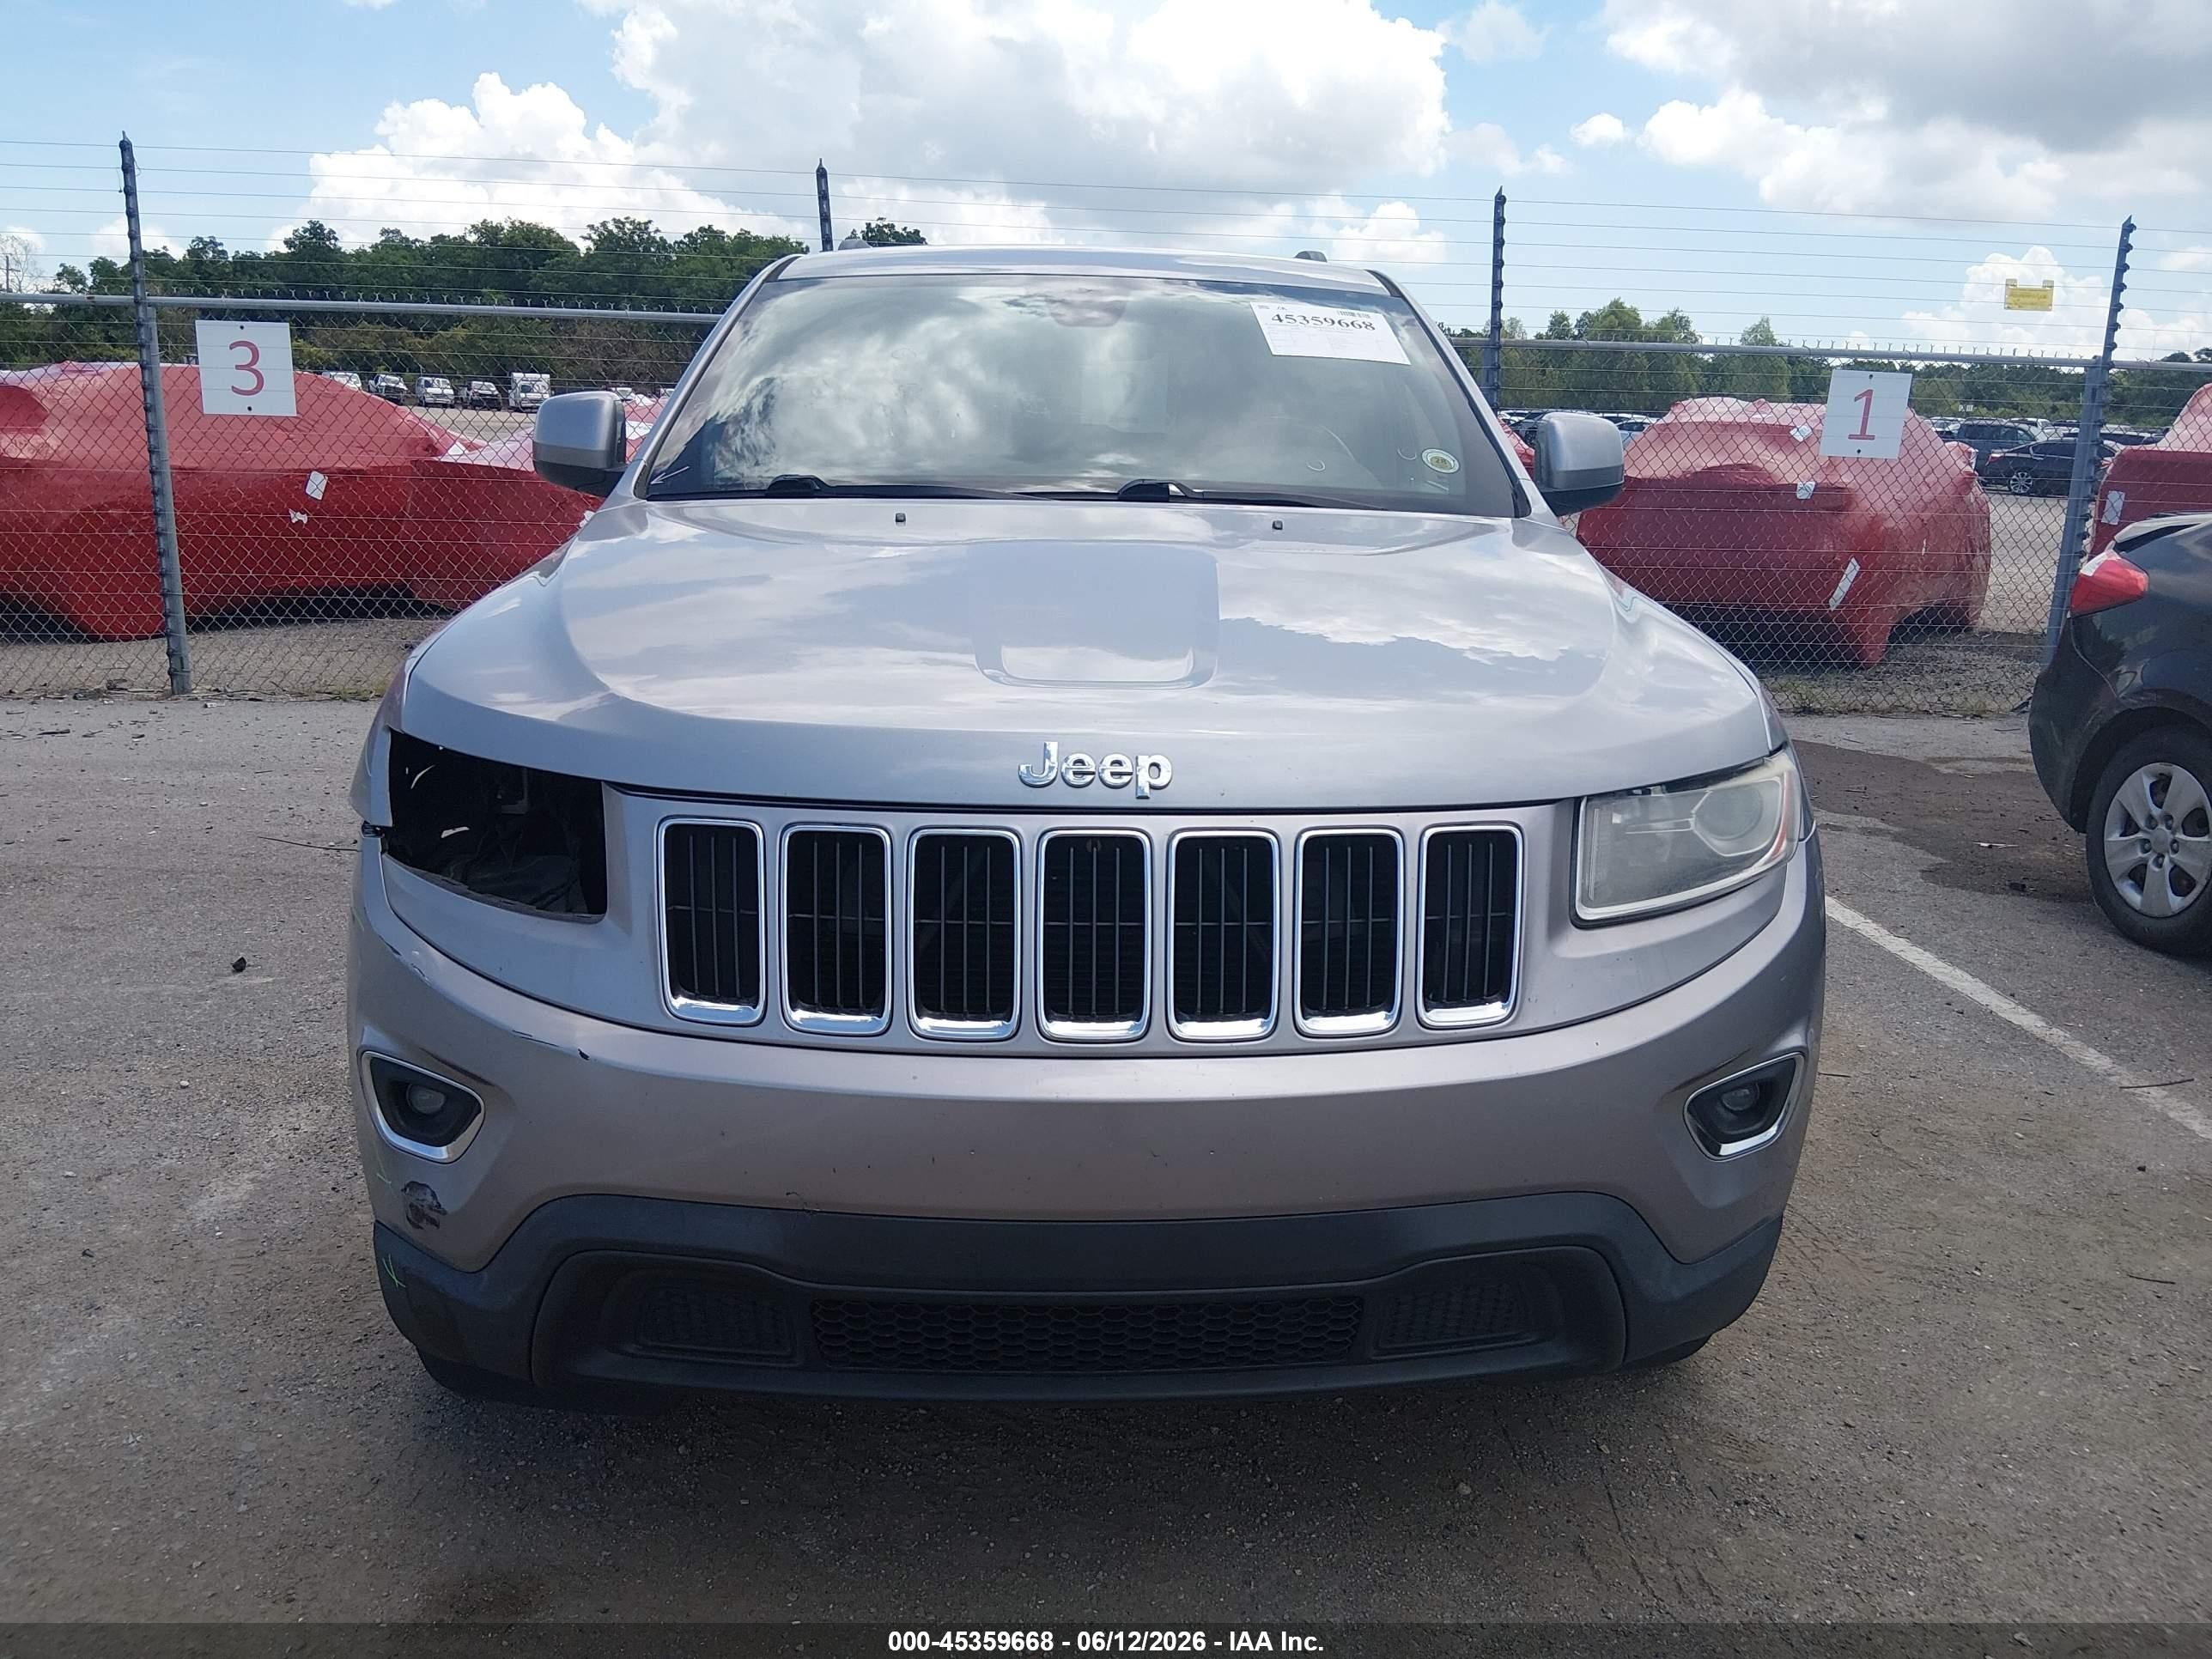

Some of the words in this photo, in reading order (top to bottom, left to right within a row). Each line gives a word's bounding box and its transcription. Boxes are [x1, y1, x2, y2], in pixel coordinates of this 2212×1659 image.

[1271, 312, 1376, 331] 45359668
[228, 340, 264, 397] 3
[1847, 388, 1876, 441] 1
[1018, 741, 1173, 799] Jeep
